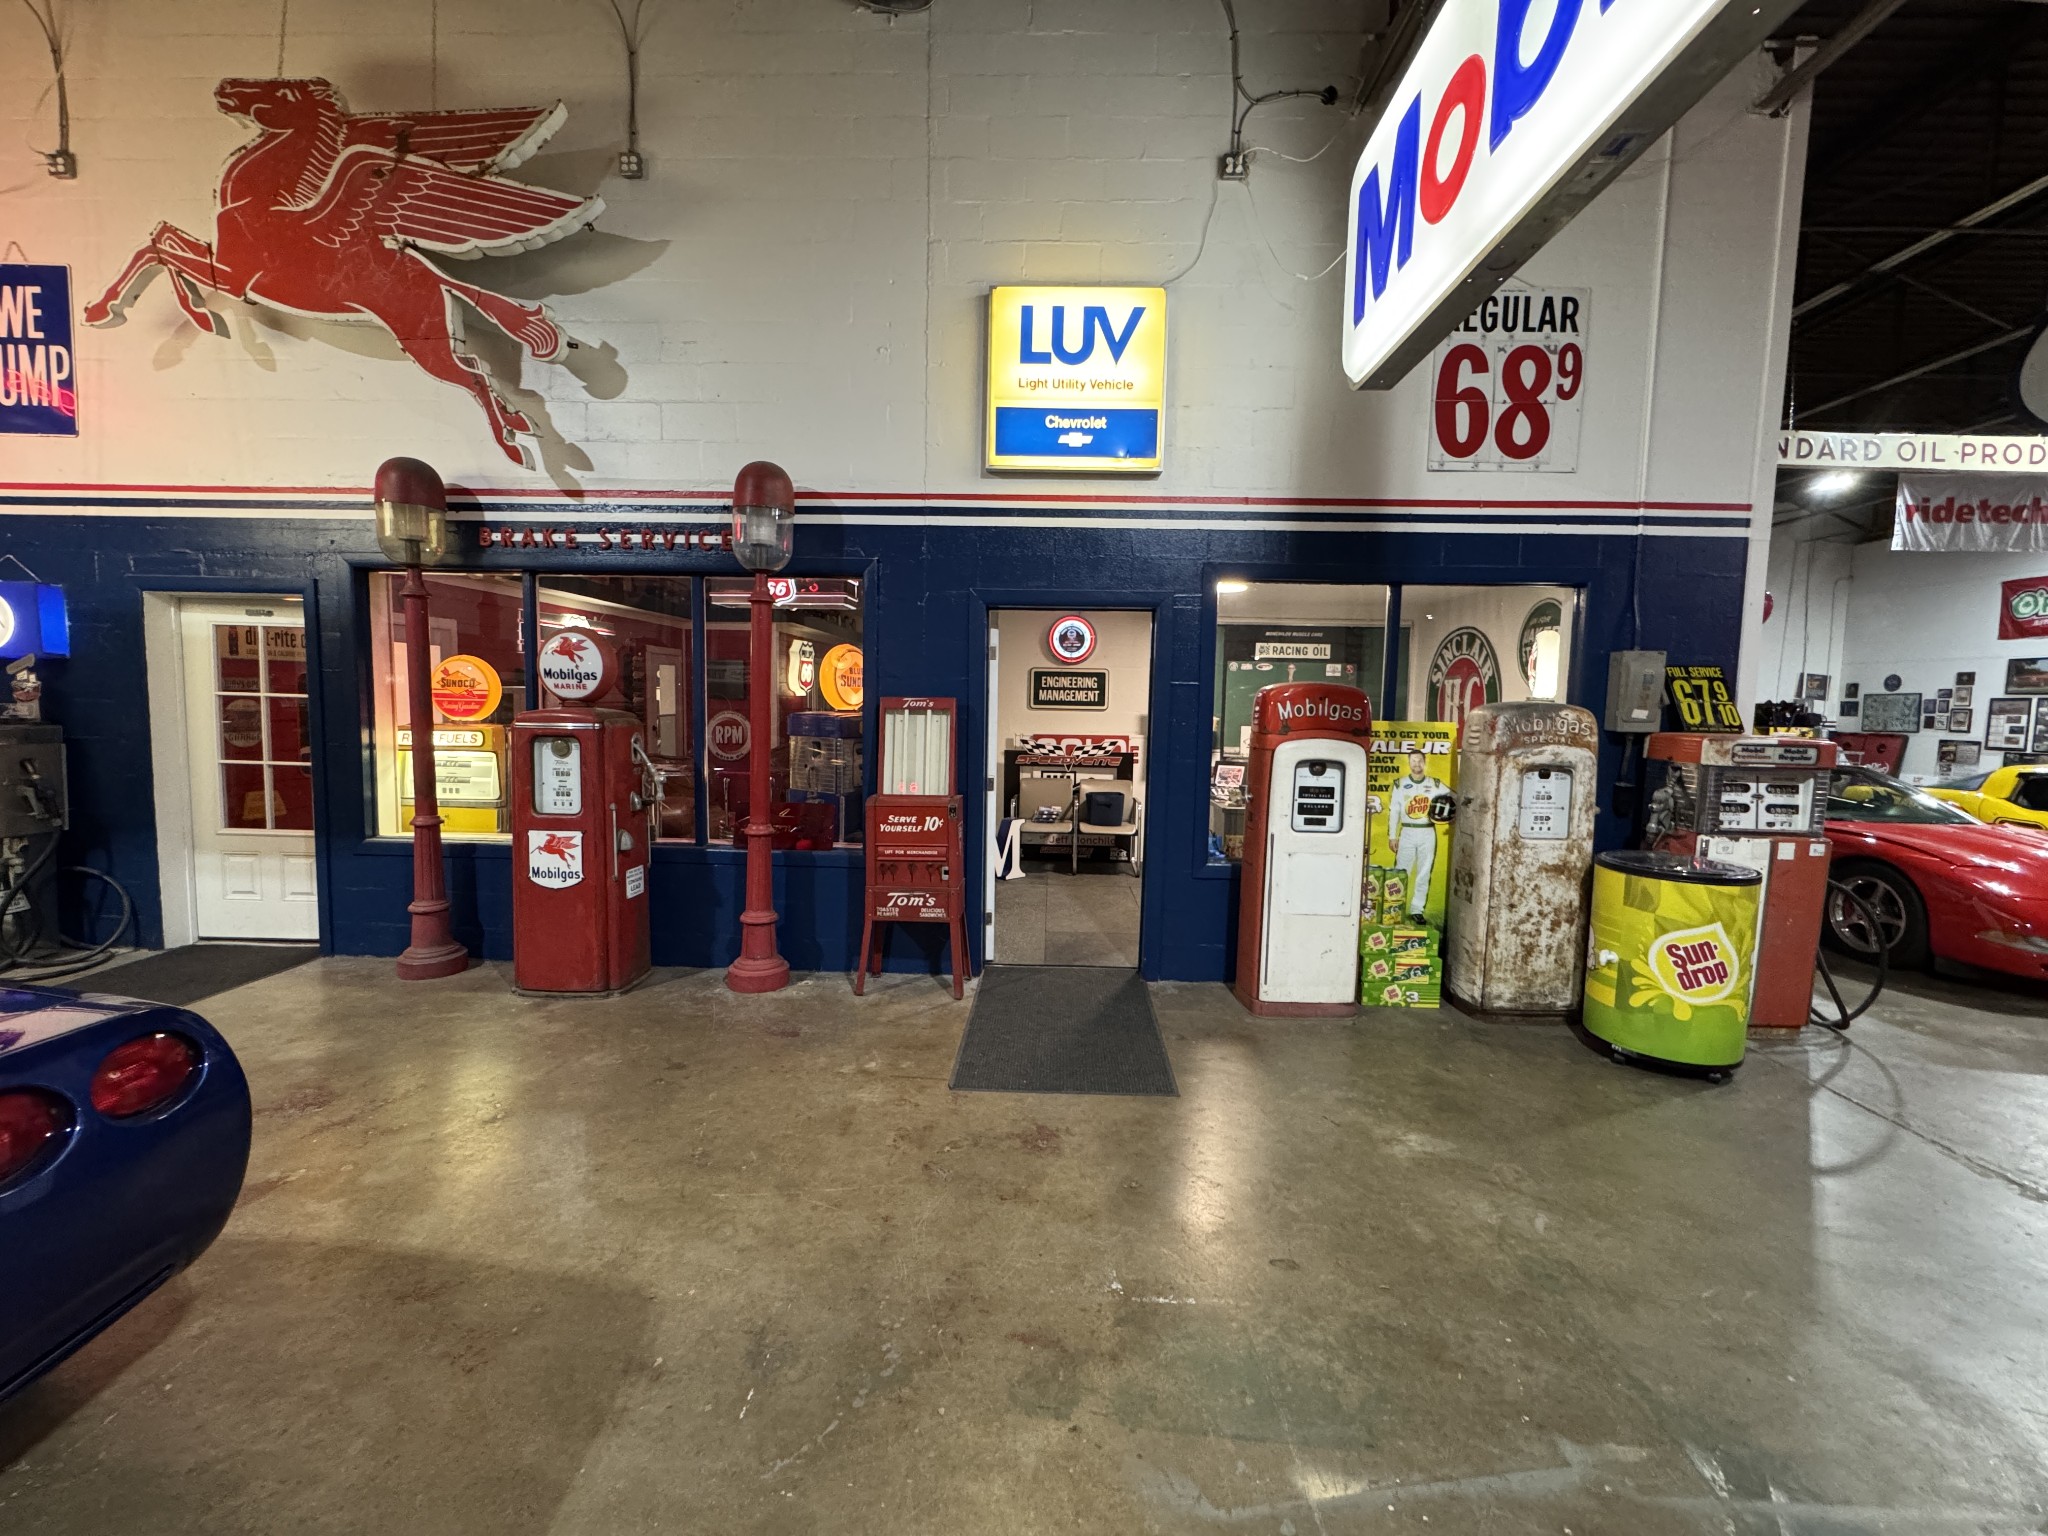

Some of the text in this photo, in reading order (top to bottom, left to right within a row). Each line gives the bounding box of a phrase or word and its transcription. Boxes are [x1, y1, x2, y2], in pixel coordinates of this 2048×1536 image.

[0, 286, 44, 338] WE
[1451, 296, 1580, 333] EGULAR
[1020, 305, 1147, 366] LUV
[0, 344, 70, 407] UMP
[1018, 378, 1134, 392] Light Utility Vehicle
[1045, 415, 1108, 430] Chevrolet
[1897, 441, 1945, 463] OIL
[1961, 442, 2046, 465] PROD
[1906, 497, 2048, 524] ridetech
[479, 527, 733, 550] BRAKE SERVICE
[1272, 645, 1329, 657] RACING OIL
[1431, 634, 1494, 687] SINCLAIR
[543, 668, 598, 684] Mobilgas
[1667, 667, 1723, 679] FULL SERVICE
[440, 677, 476, 689] SUNOCO
[1041, 676, 1098, 689] ENGINEERING
[903, 697, 934, 708] Tom's
[1039, 690, 1100, 702] MANAGEMENT
[1277, 698, 1363, 721] Mobilgas
[1502, 711, 1592, 736] Mobilgas
[439, 733, 478, 744] FUELS
[715, 725, 742, 744] RPM
[1399, 731, 1420, 739] GET
[1422, 731, 1450, 739] YOUR
[1523, 735, 1573, 745] SPECIAL
[1421, 741, 1452, 754] JR
[1015, 755, 1123, 767] SPEEDVETTE
[1778, 754, 1813, 762] Regular
[1410, 795, 1429, 806] Sun
[887, 815, 917, 823] SERVE
[880, 824, 922, 832] YOURSELF
[531, 866, 580, 882] Mobilgas
[887, 892, 936, 907] Tom's
[1676, 960, 1728, 990] drop
